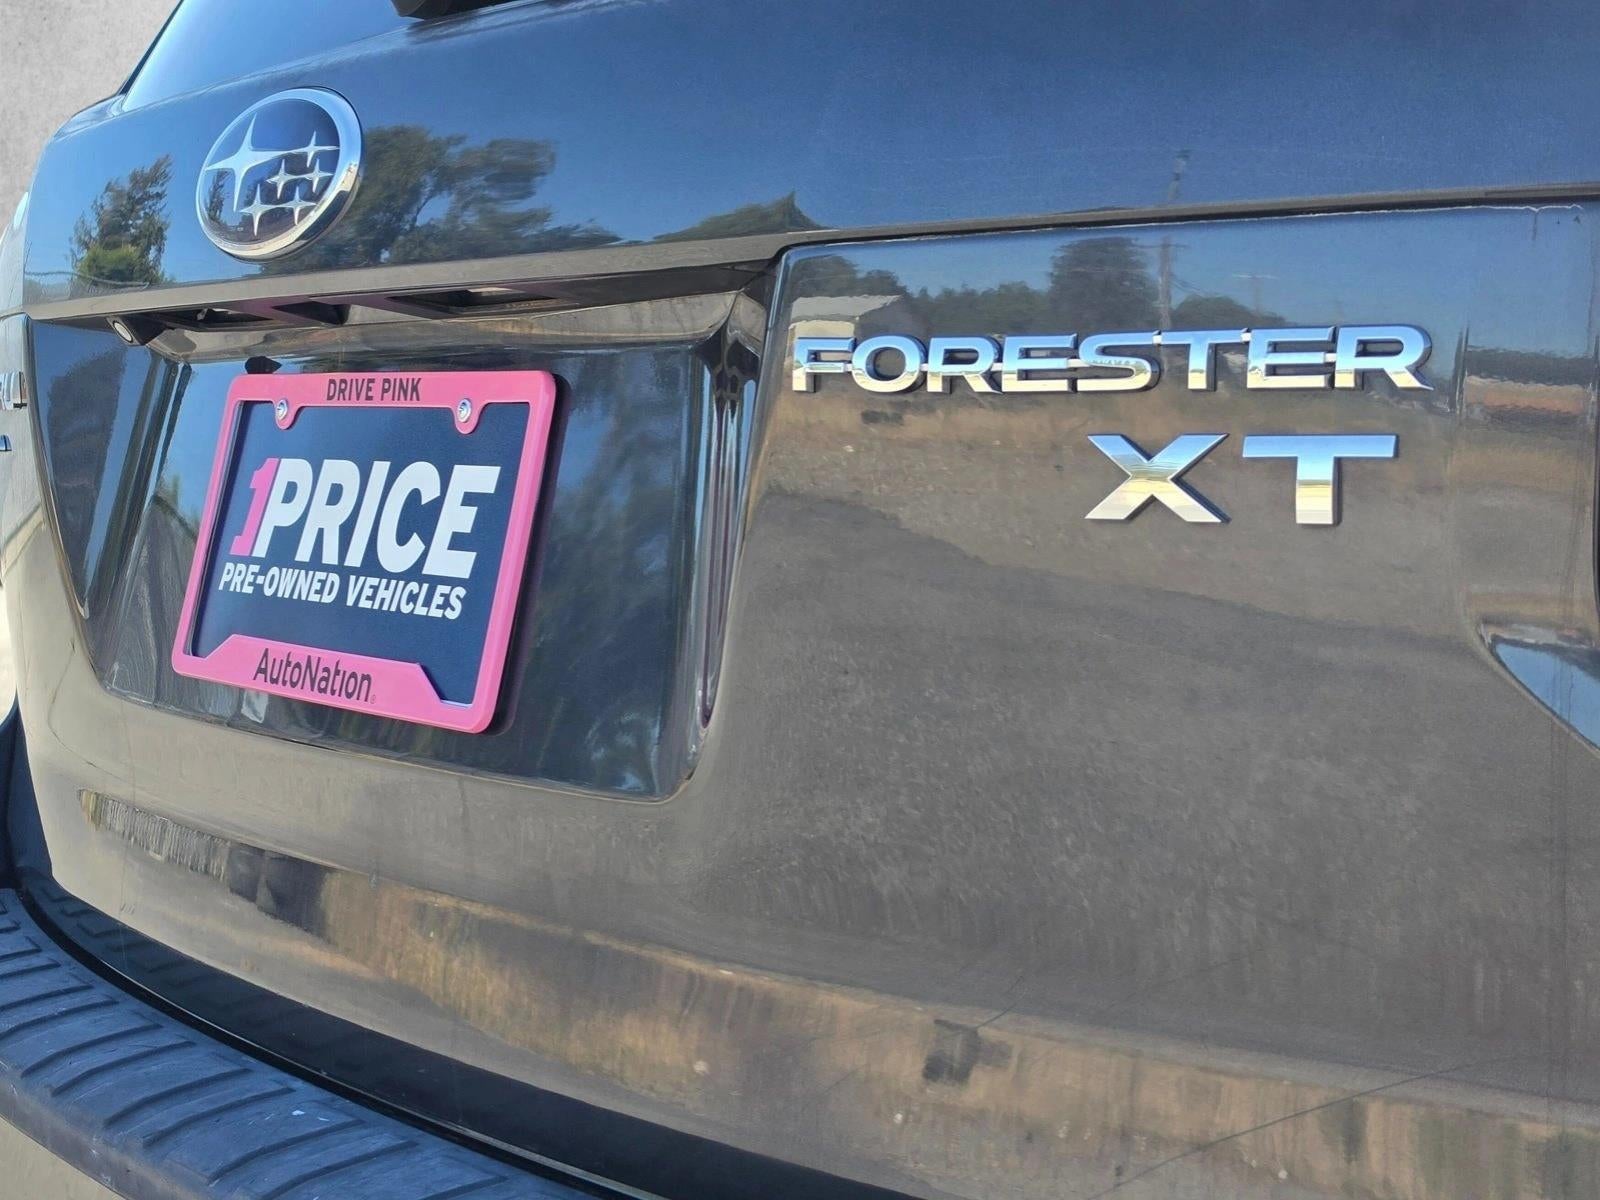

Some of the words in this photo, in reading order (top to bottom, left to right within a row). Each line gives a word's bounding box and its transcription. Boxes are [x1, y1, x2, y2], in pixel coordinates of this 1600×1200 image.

[792, 325, 1433, 393] FORESTER
[326, 377, 375, 402] DRIVE
[380, 377, 422, 402] PINK
[1084, 433, 1399, 525] XT
[218, 562, 340, 604] PRE-OWNED
[345, 575, 467, 620] VEHICLES
[253, 648, 373, 703] AutoNation
